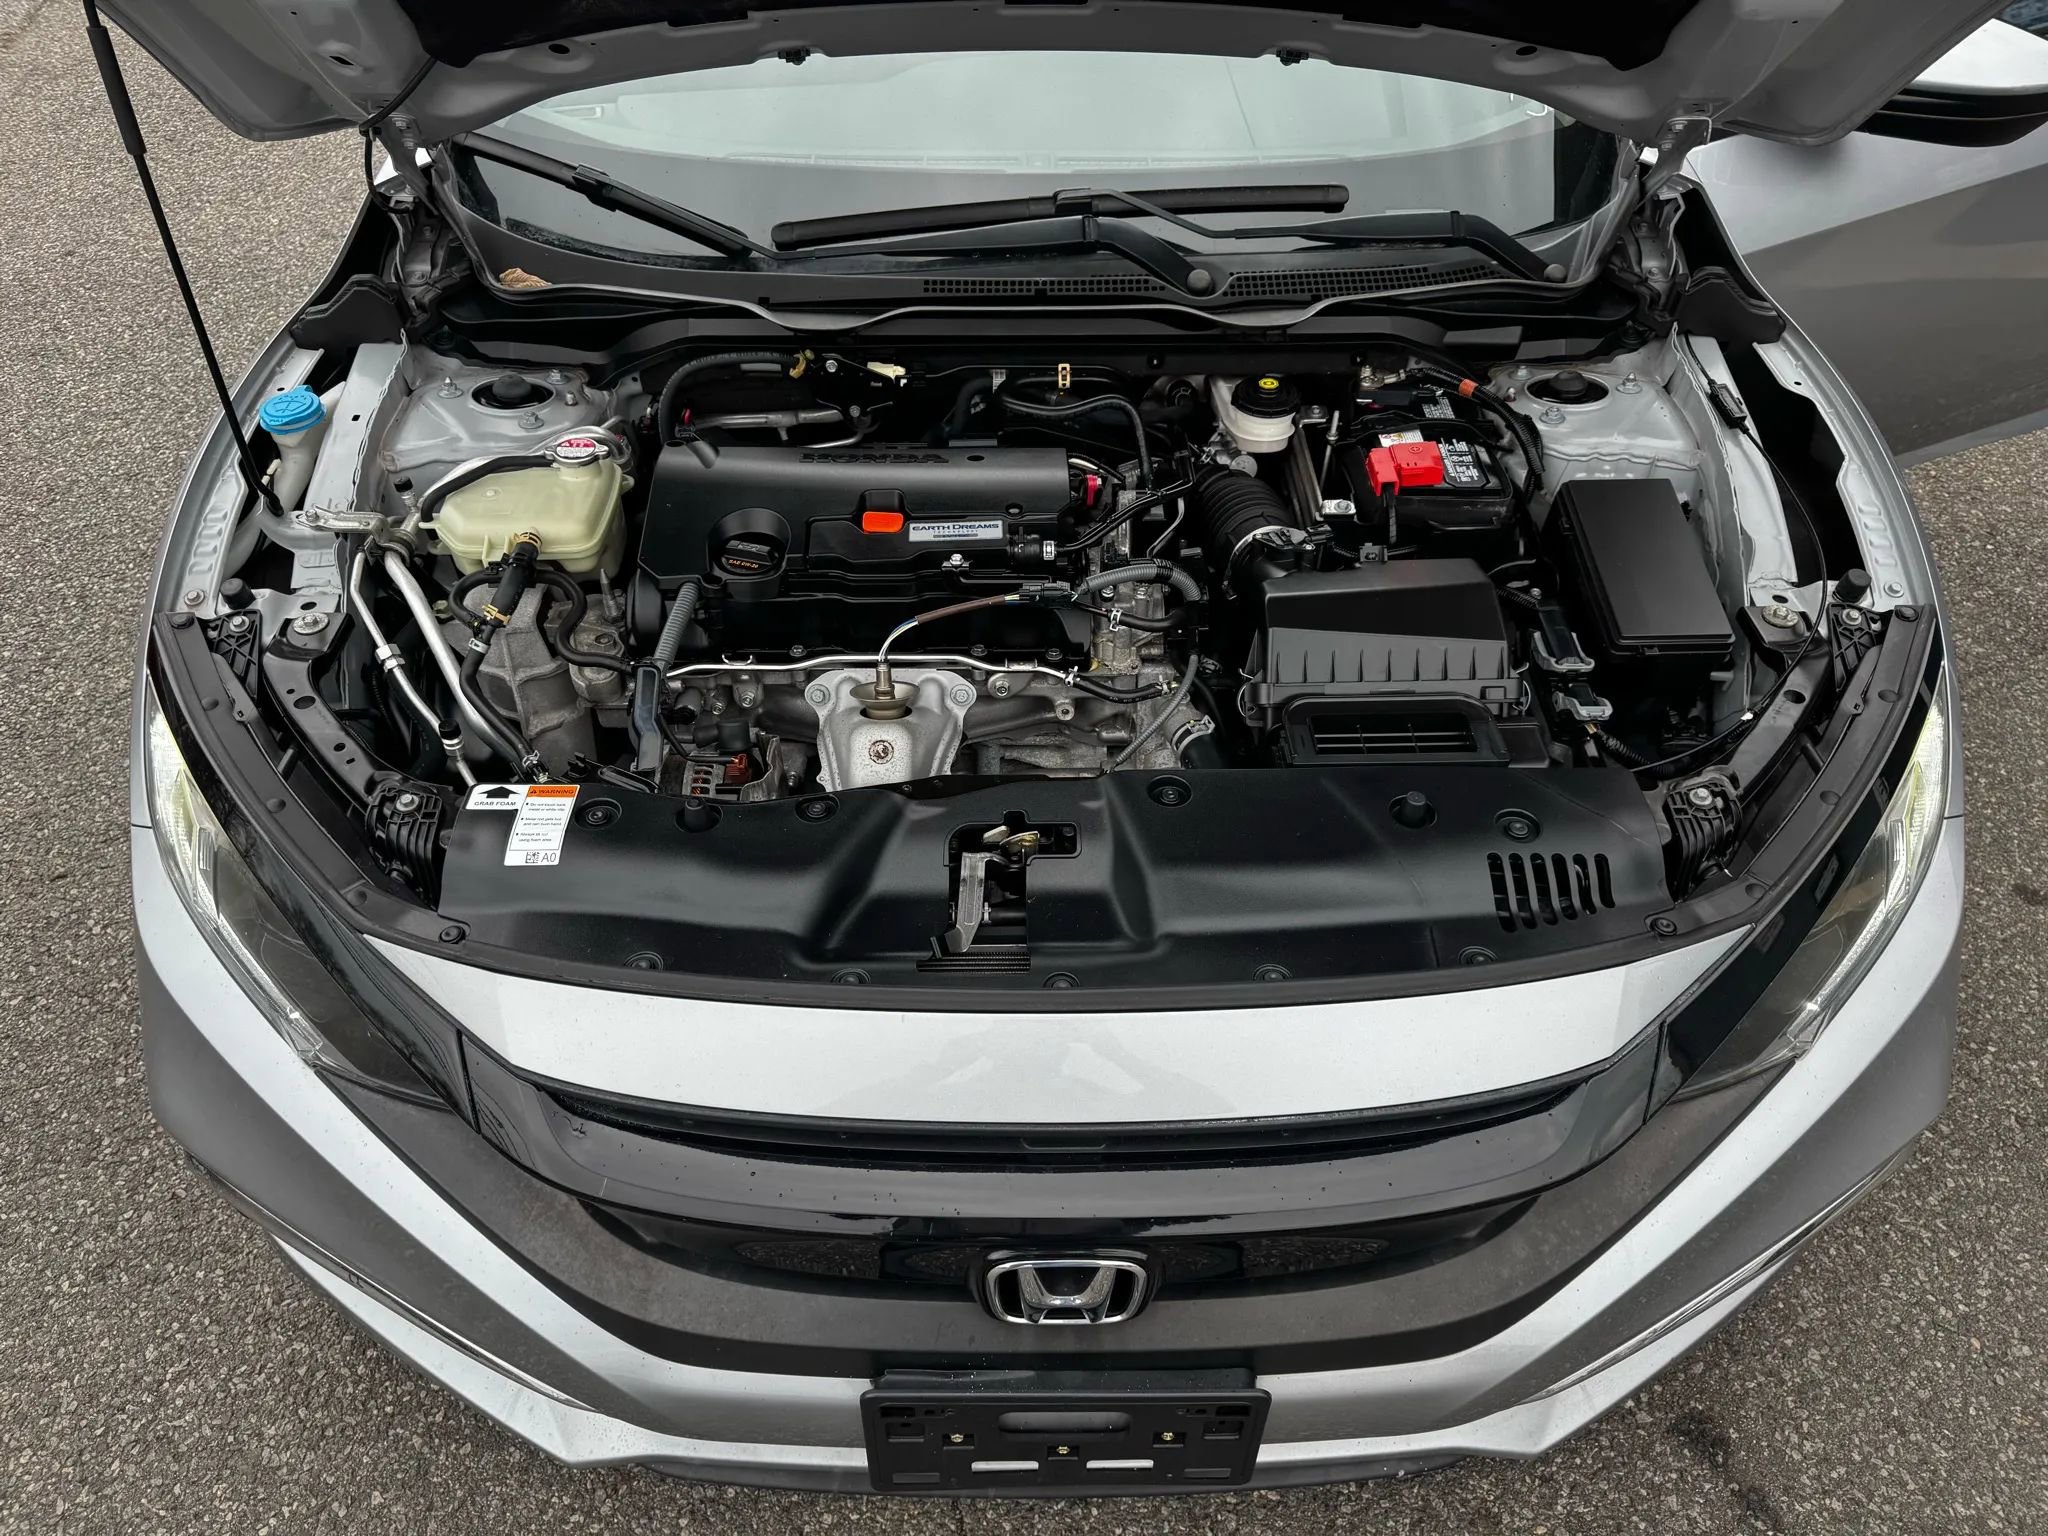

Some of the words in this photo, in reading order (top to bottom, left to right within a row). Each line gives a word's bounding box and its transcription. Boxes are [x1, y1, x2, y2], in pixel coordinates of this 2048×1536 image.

[799, 453, 949, 463] HONDA
[741, 561, 759, 569] 0W-20
[541, 852, 557, 863] A0
